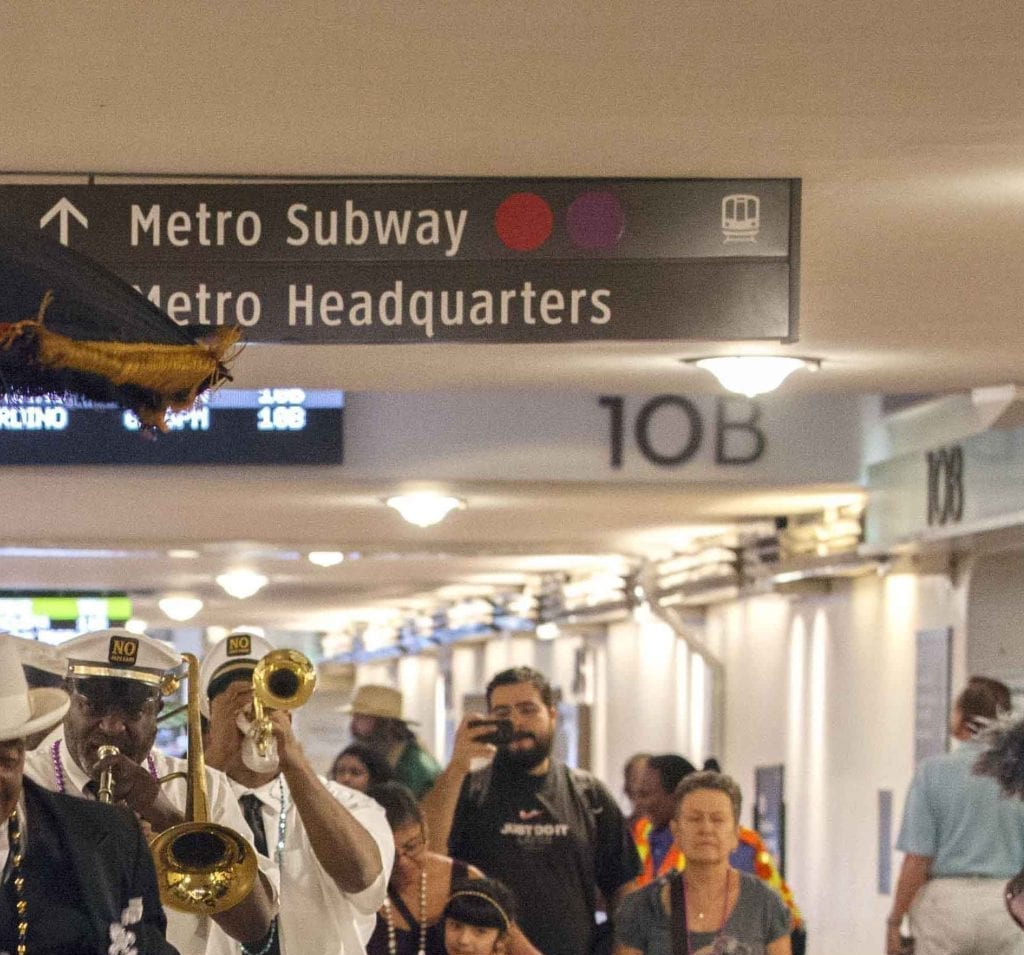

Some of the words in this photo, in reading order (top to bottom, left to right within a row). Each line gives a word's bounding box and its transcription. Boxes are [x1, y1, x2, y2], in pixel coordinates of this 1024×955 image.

[130, 202, 263, 247] Metro
[286, 202, 468, 259] Subway
[288, 281, 613, 338] Headquarters
[597, 393, 767, 470] 10B
[112, 639, 136, 656] NO
[229, 636, 249, 649] NO
